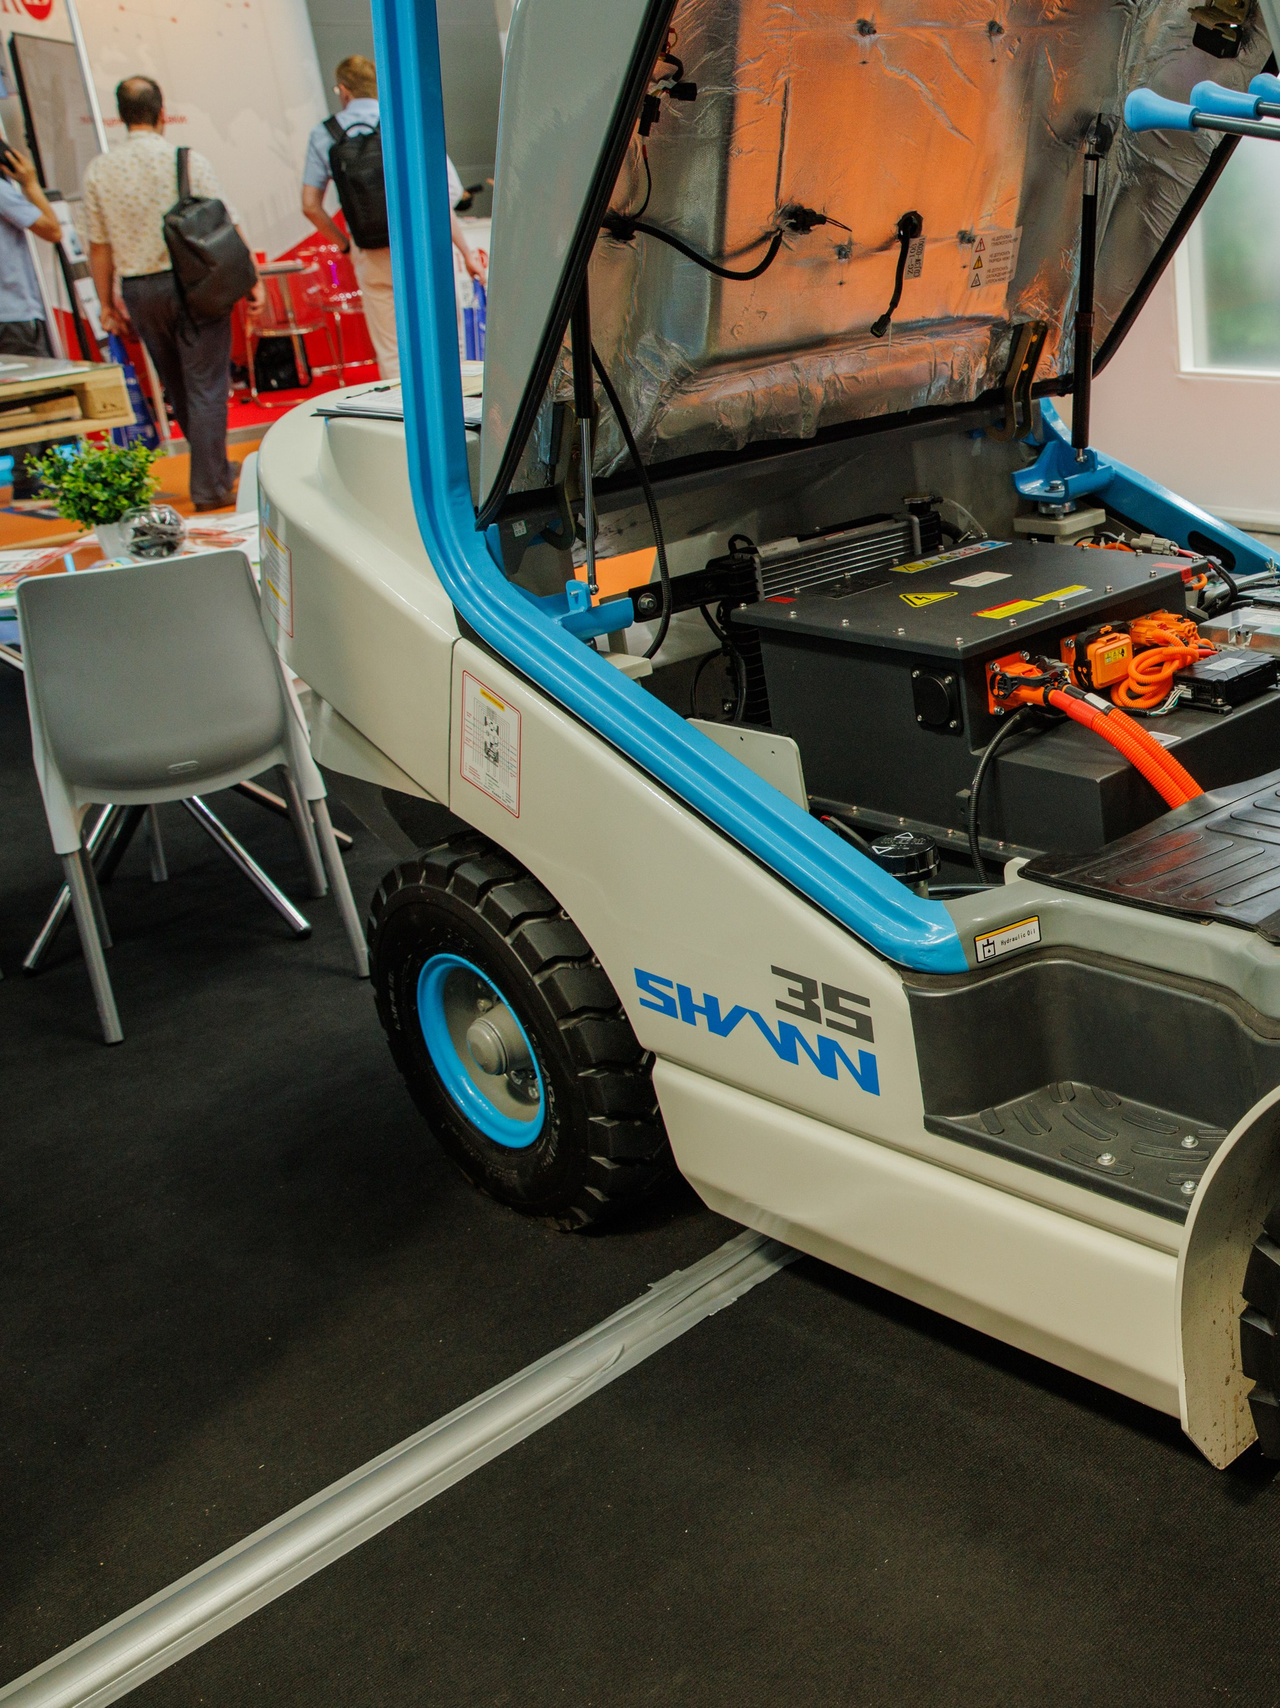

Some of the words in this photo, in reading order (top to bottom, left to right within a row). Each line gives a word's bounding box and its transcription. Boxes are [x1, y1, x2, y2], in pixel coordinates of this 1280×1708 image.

[1000, 932, 1026, 947] Hydraulic
[1026, 928, 1036, 937] Oil
[634, 968, 880, 1096] SHANN
[771, 965, 875, 1043] 35
